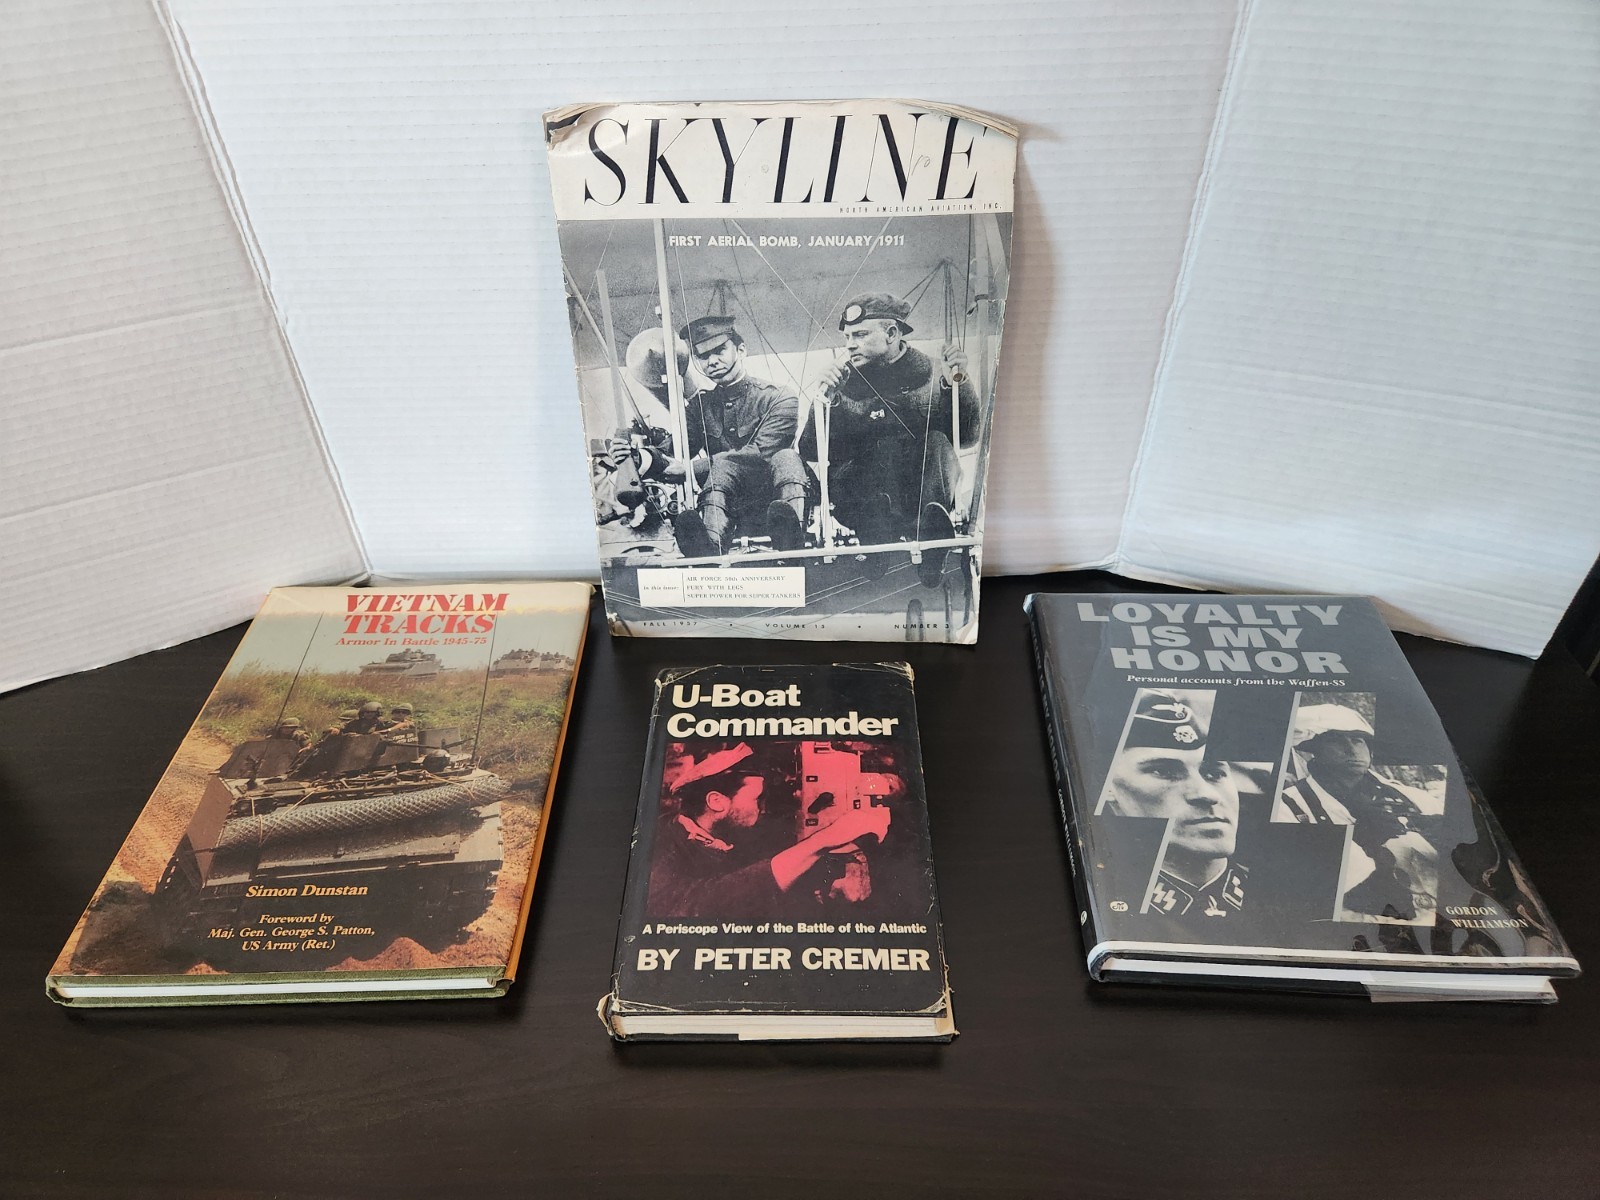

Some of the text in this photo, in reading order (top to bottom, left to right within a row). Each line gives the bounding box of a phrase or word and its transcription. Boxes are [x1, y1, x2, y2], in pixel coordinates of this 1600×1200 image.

[584, 112, 988, 207] SKYLINE
[669, 235, 905, 248] FIRST AERIAL BOMB, JANUARY 1911
[347, 593, 509, 613] VIETNAM
[1077, 602, 1343, 625] LOYALTY
[343, 614, 498, 634] TRACKS
[336, 636, 487, 646] Armor In Battle 1945-75
[1131, 625, 1303, 649] IS MY
[1110, 647, 1350, 674] HONOR
[1127, 674, 1178, 683] Personal
[1233, 678, 1264, 686] from
[1288, 679, 1346, 687] Waffen-SS
[672, 684, 801, 709] U-Boat
[667, 711, 899, 738] Commander
[245, 884, 369, 898] Simon Dunstan
[1445, 906, 1498, 915] GORDON
[258, 914, 335, 925] Foreword by
[1451, 918, 1529, 928] WILLIAMSON
[207, 925, 376, 939] Maj. Gen. George S. Patton,
[642, 923, 927, 935] A Periscope View of the Battle of the Atlantic
[241, 939, 336, 952] US Army (Ret.)
[637, 948, 930, 971] BY PETER CREMER
